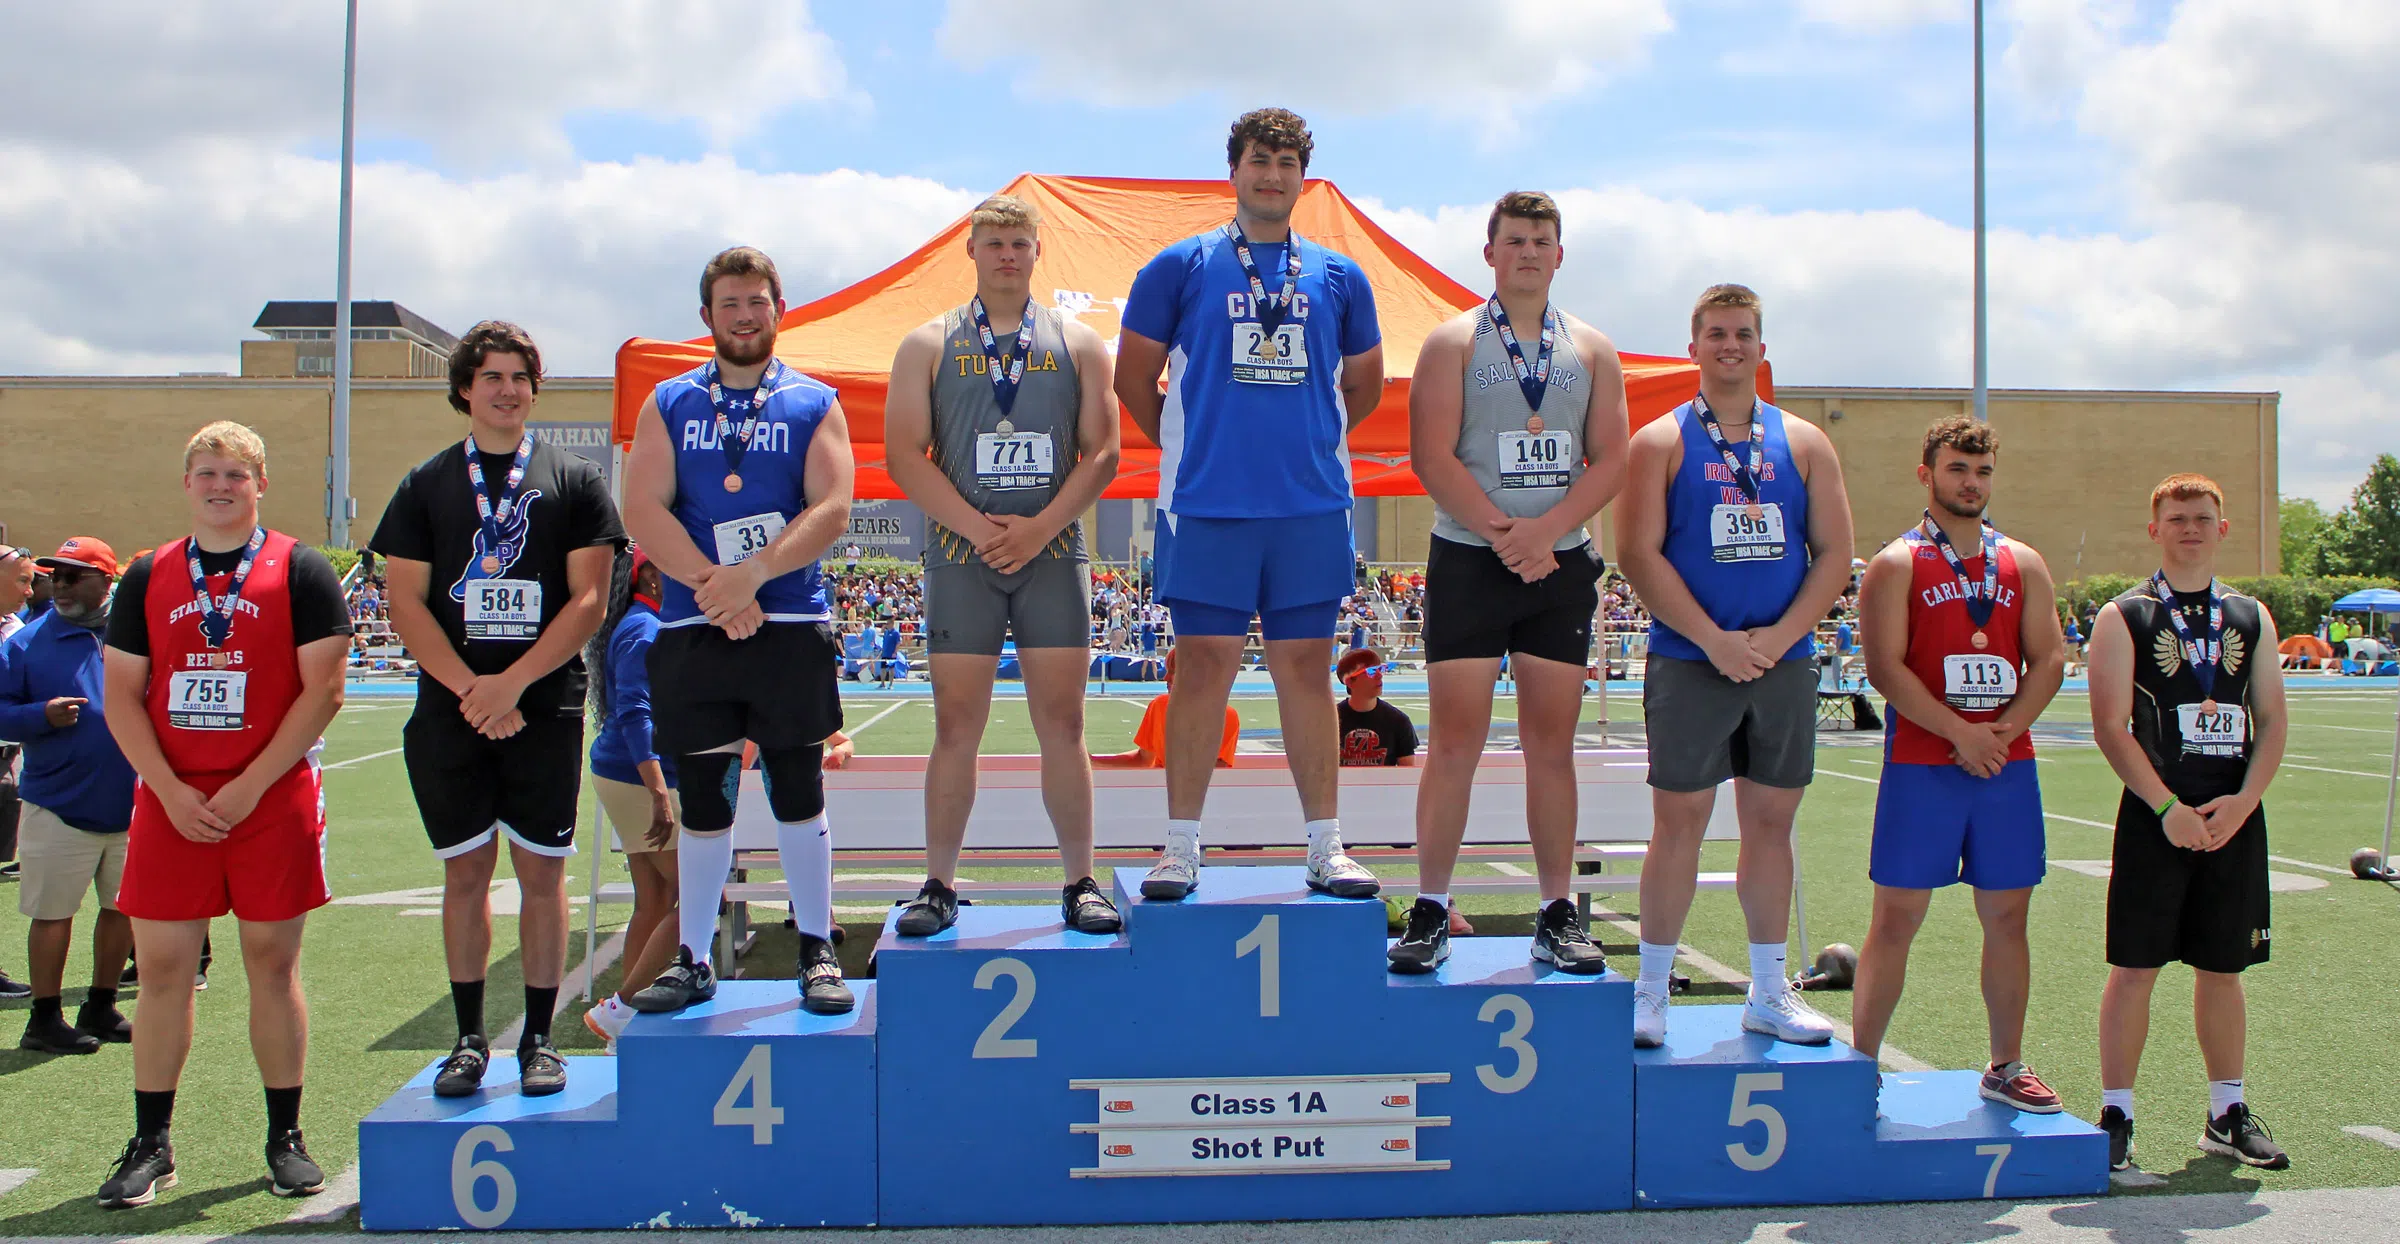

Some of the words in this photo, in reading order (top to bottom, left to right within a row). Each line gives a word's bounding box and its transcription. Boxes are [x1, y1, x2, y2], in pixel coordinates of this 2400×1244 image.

[1249, 332, 1291, 357] 23
[954, 350, 1059, 377] TUCLA
[1475, 362, 1516, 390] SAL
[1530, 363, 1578, 394] FRK
[993, 441, 1035, 464] 771
[1517, 438, 1557, 463] 140
[992, 465, 1012, 473] CLASS
[1726, 513, 1768, 534] 396
[738, 524, 768, 551] 33
[889, 536, 911, 544] COACH
[481, 588, 525, 612] 584
[1962, 663, 2002, 685] 113
[185, 679, 228, 703] 755
[2195, 712, 2233, 733] 428
[1237, 915, 1279, 1016] 1
[973, 959, 1036, 1058] 2
[1477, 995, 1537, 1093] 3
[714, 1046, 783, 1144] 4
[1191, 1093, 1276, 1116] Class
[1287, 1091, 1328, 1114] 1A
[1727, 1073, 1787, 1170] 5
[1191, 1137, 1263, 1159] Shot
[1275, 1136, 1325, 1158] Put
[452, 1126, 515, 1228] 6
[1977, 1144, 2011, 1197] 7
